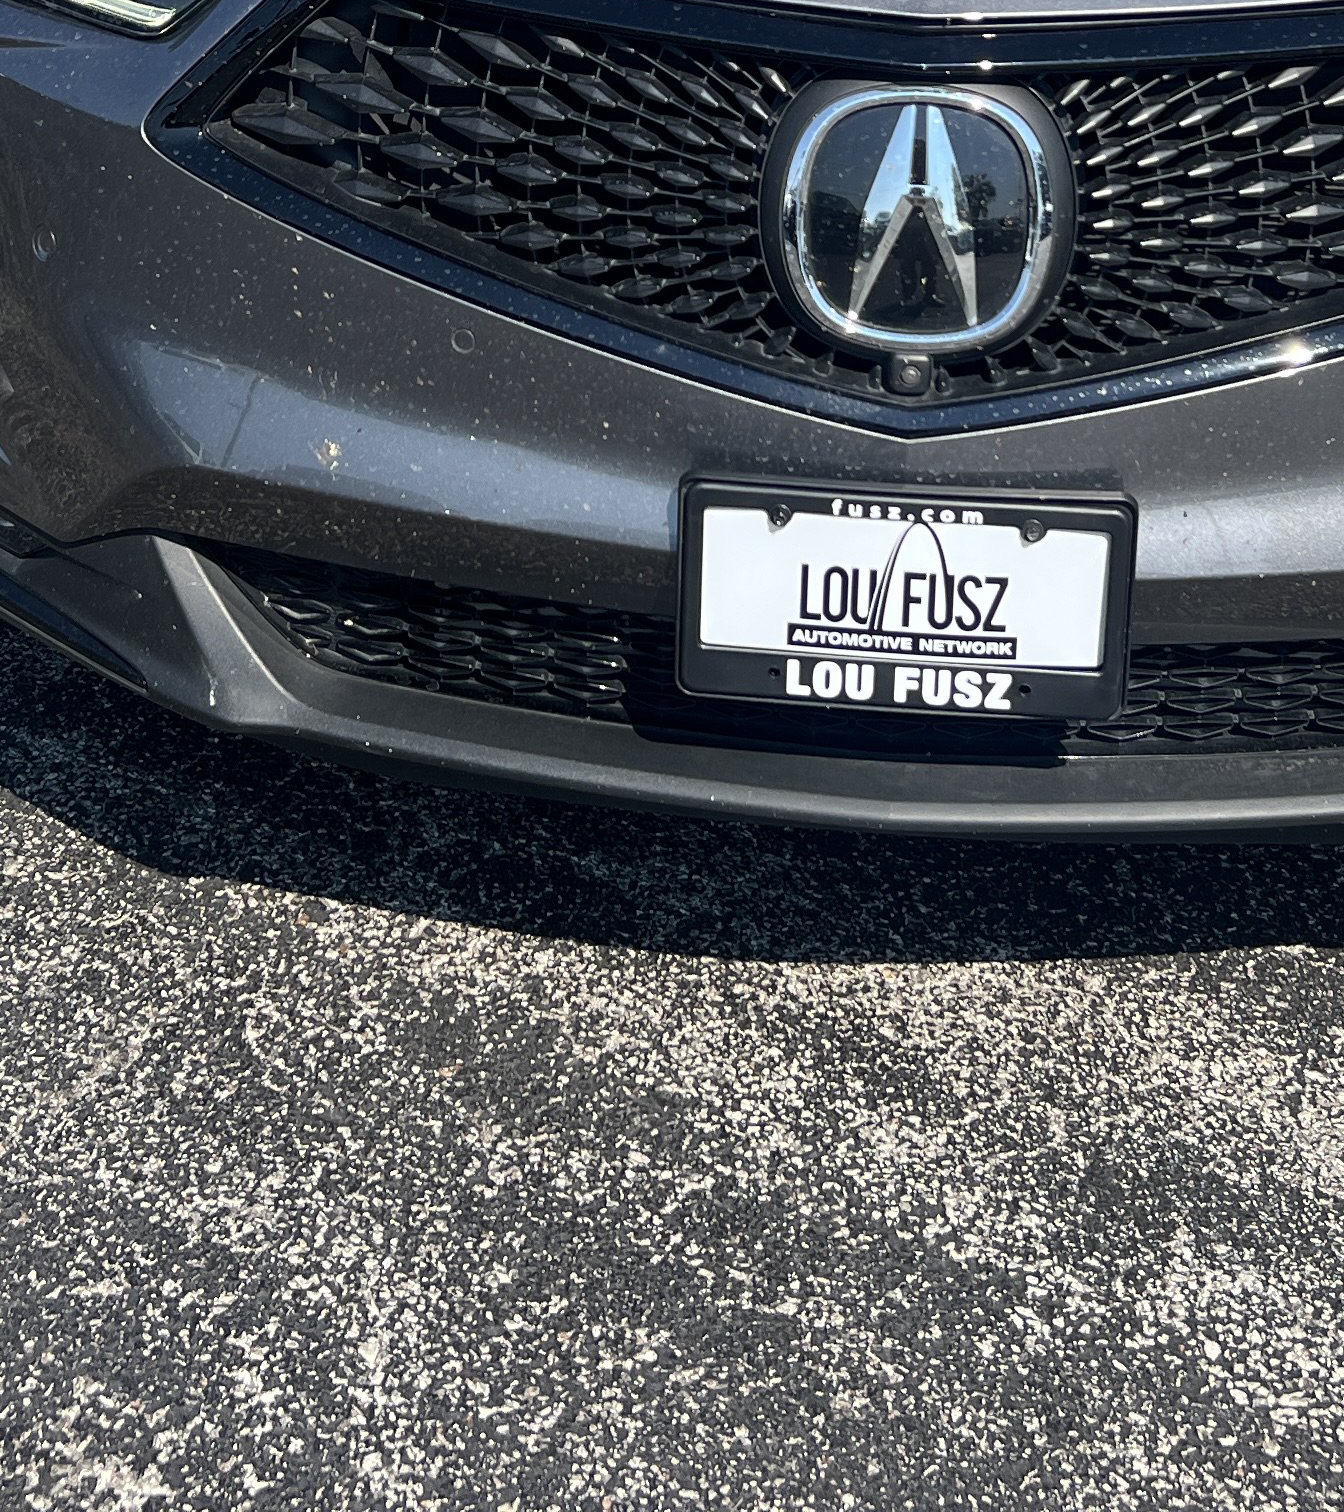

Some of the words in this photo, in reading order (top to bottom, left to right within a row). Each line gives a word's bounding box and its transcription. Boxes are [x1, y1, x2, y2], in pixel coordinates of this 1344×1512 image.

[830, 498, 985, 525] fusz.com
[799, 563, 878, 625] LOU
[901, 571, 1009, 633] FUSZ
[791, 628, 913, 652] AUTOMOTIVE
[918, 638, 1014, 657] NETWORK
[785, 658, 875, 701] LOU
[893, 665, 1014, 710] FUSZ
